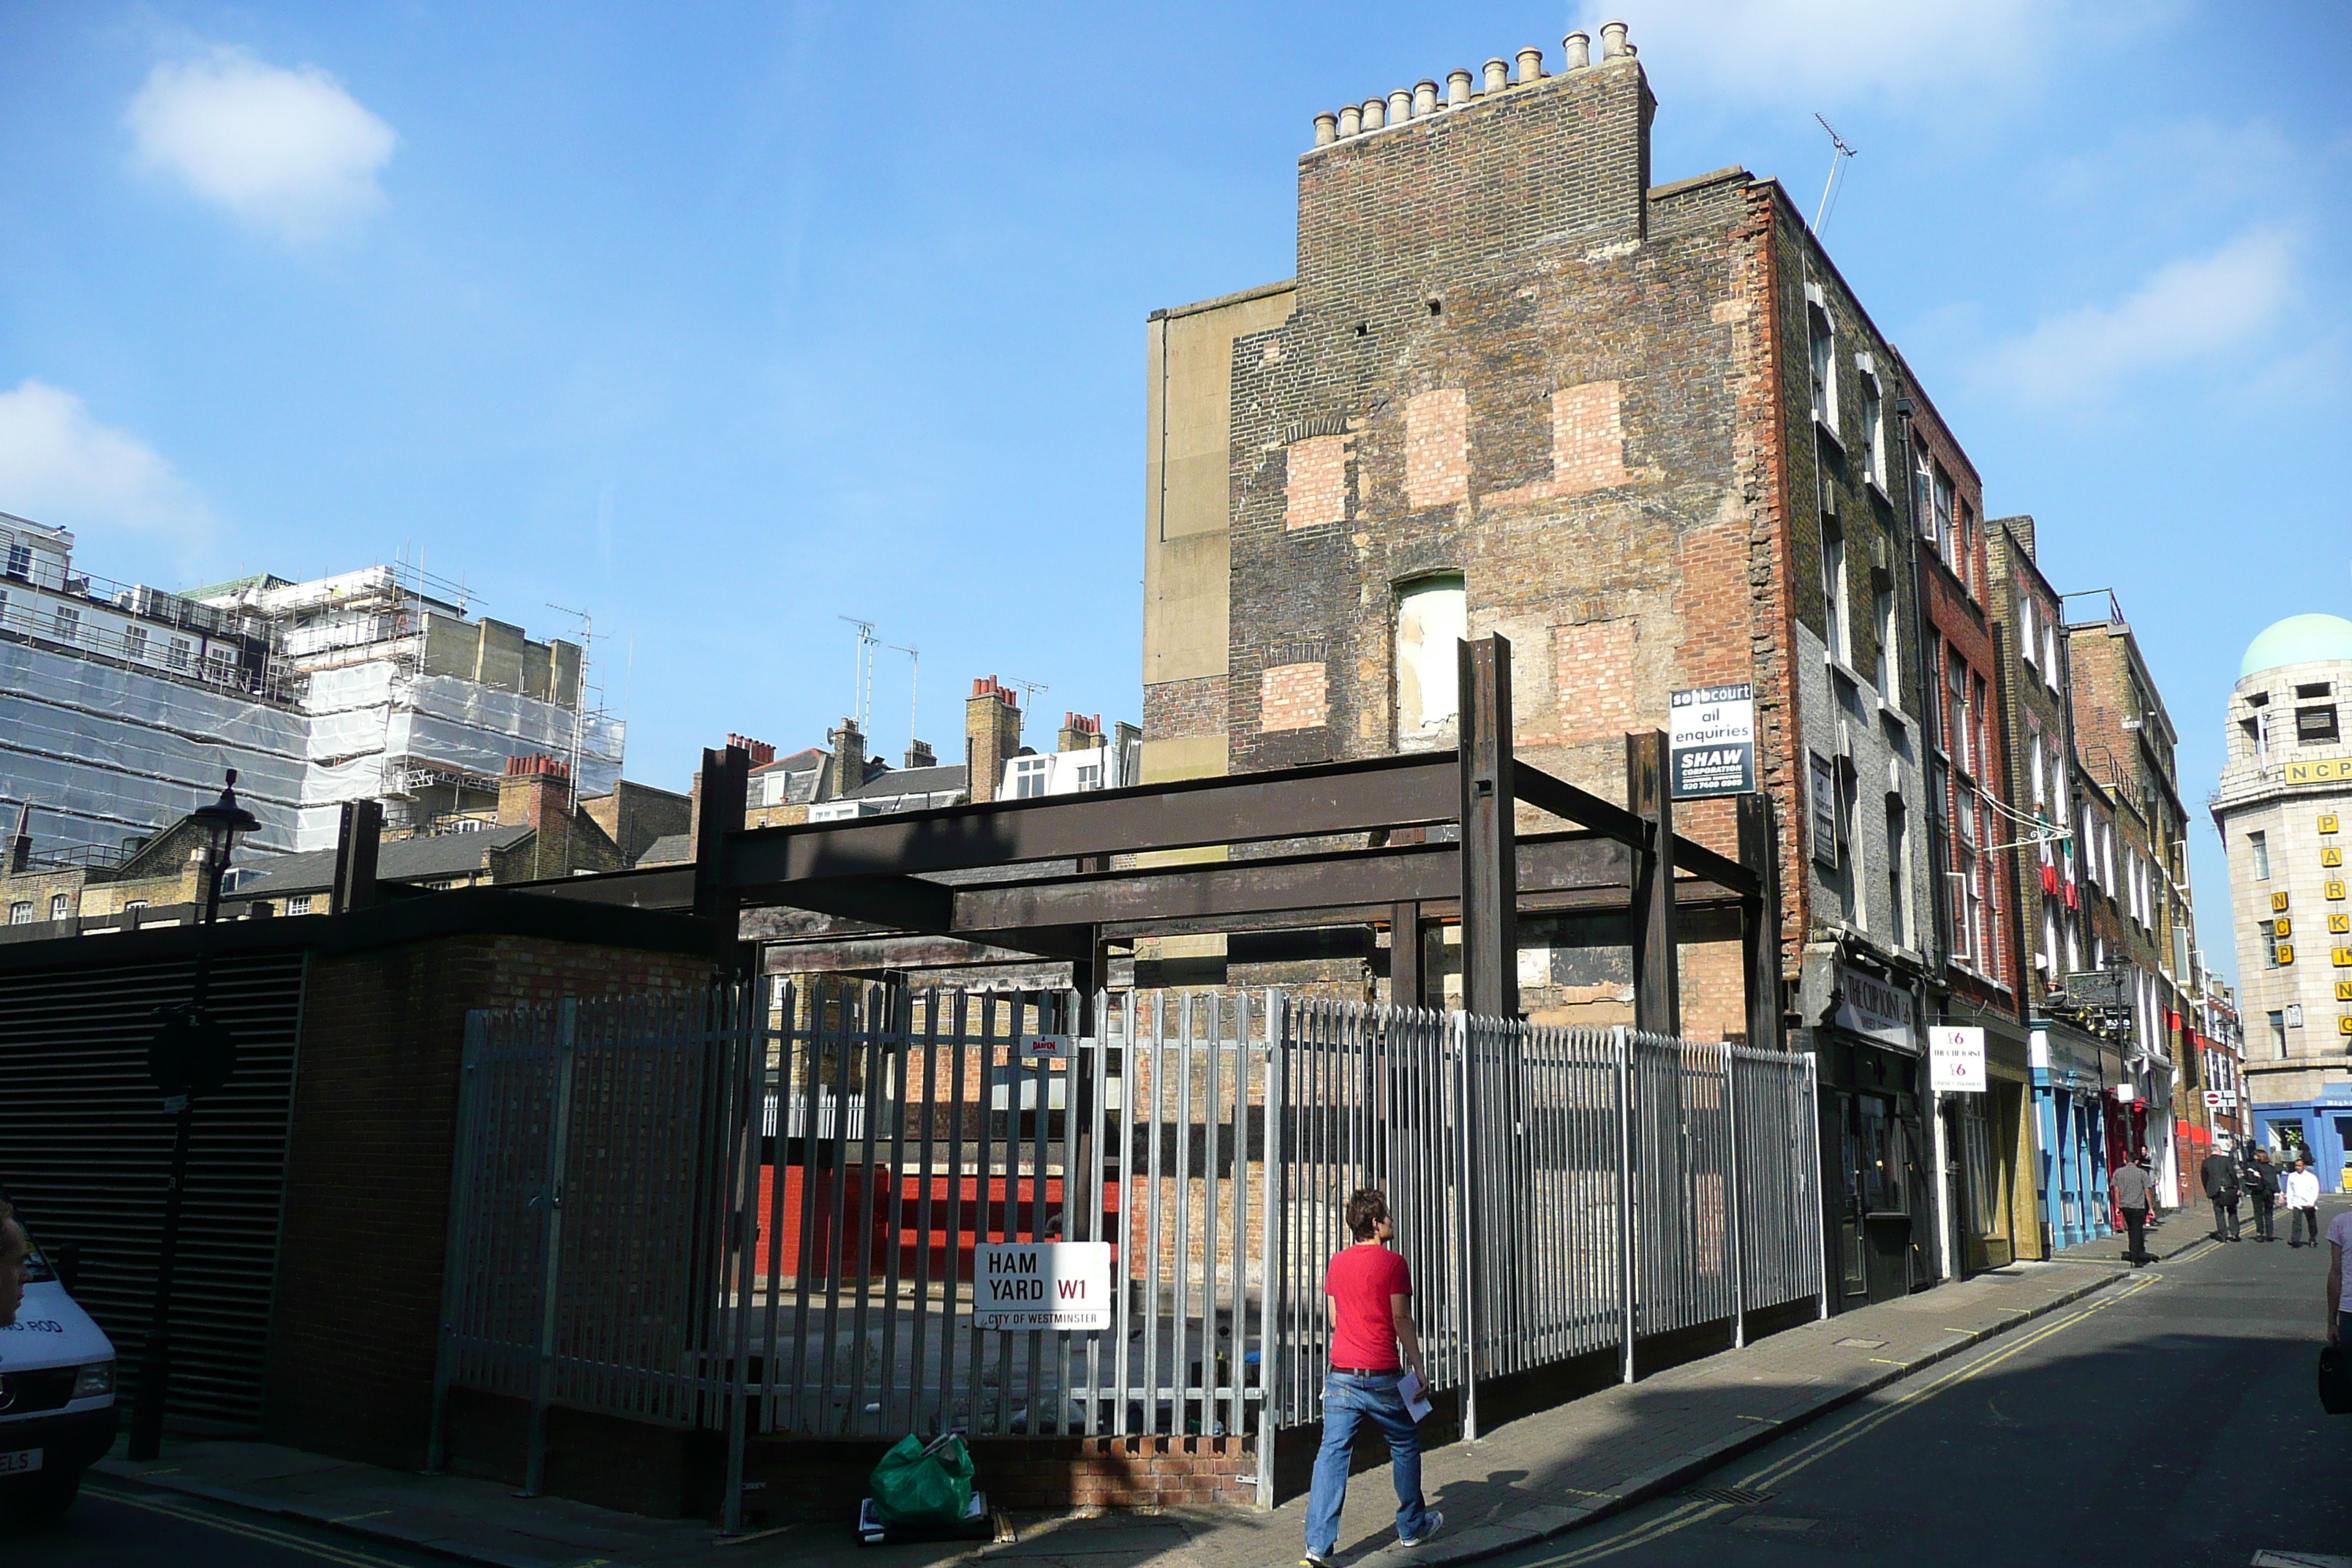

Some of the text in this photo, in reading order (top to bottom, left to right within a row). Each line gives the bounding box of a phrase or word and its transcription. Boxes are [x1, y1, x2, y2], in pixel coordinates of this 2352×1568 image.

[1703, 708, 1719, 722] all
[1676, 724, 1749, 742] enquiries
[1681, 749, 1744, 769] SHAW
[1682, 764, 1742, 776] CORPORATION
[2292, 762, 2351, 779] NCP
[2274, 894, 2290, 957] NCP
[2322, 817, 2352, 1031] PARKING
[1847, 975, 1863, 1009] THE
[1863, 981, 1879, 1014] CLIP
[1879, 988, 1899, 1022] JOINT
[1948, 1032, 1964, 1044] £6
[1950, 1063, 1966, 1076] £6
[988, 1253, 1036, 1273] HAM
[989, 1279, 1085, 1300] YARD W1
[27, 1320, 63, 1333] ROD
[988, 1313, 1097, 1324] CITY OF WESTMINSTER
